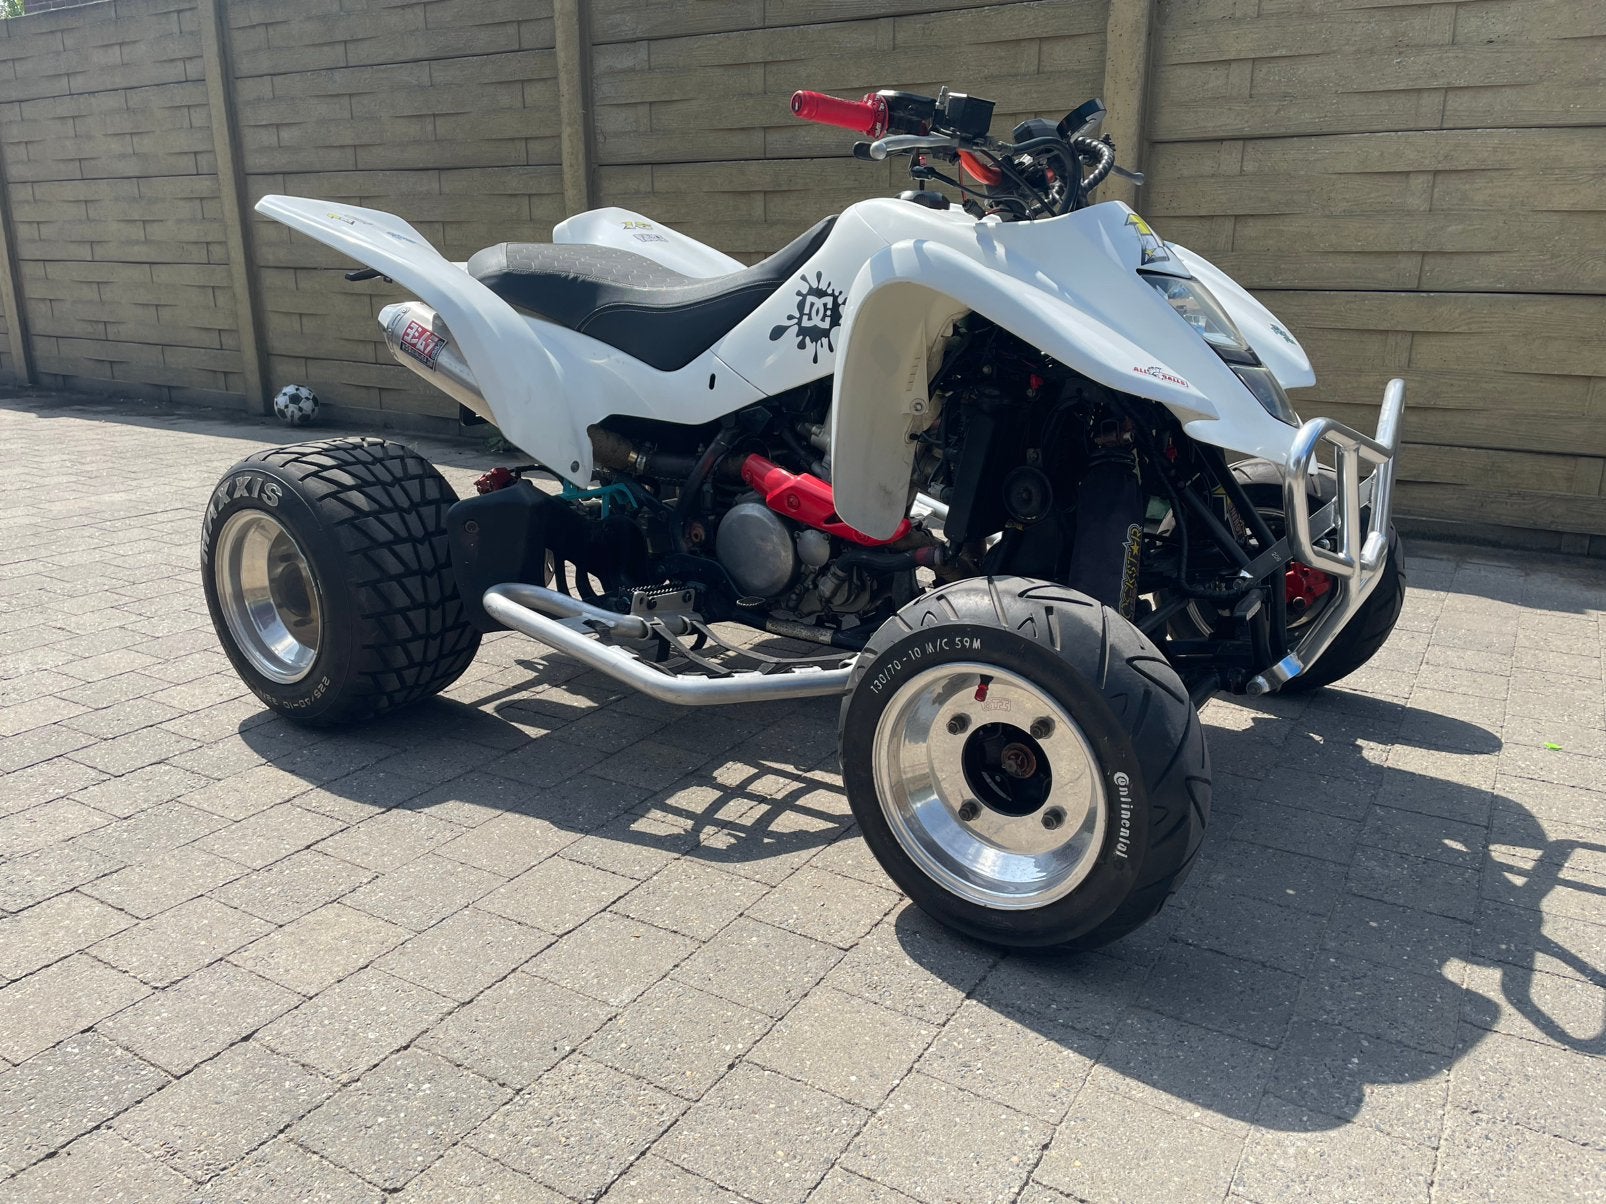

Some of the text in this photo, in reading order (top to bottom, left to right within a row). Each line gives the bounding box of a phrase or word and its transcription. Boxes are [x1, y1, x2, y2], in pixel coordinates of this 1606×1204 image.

[201, 475, 283, 565] MAXXIS
[925, 638, 950, 655] M/C
[955, 637, 981, 650] 59M
